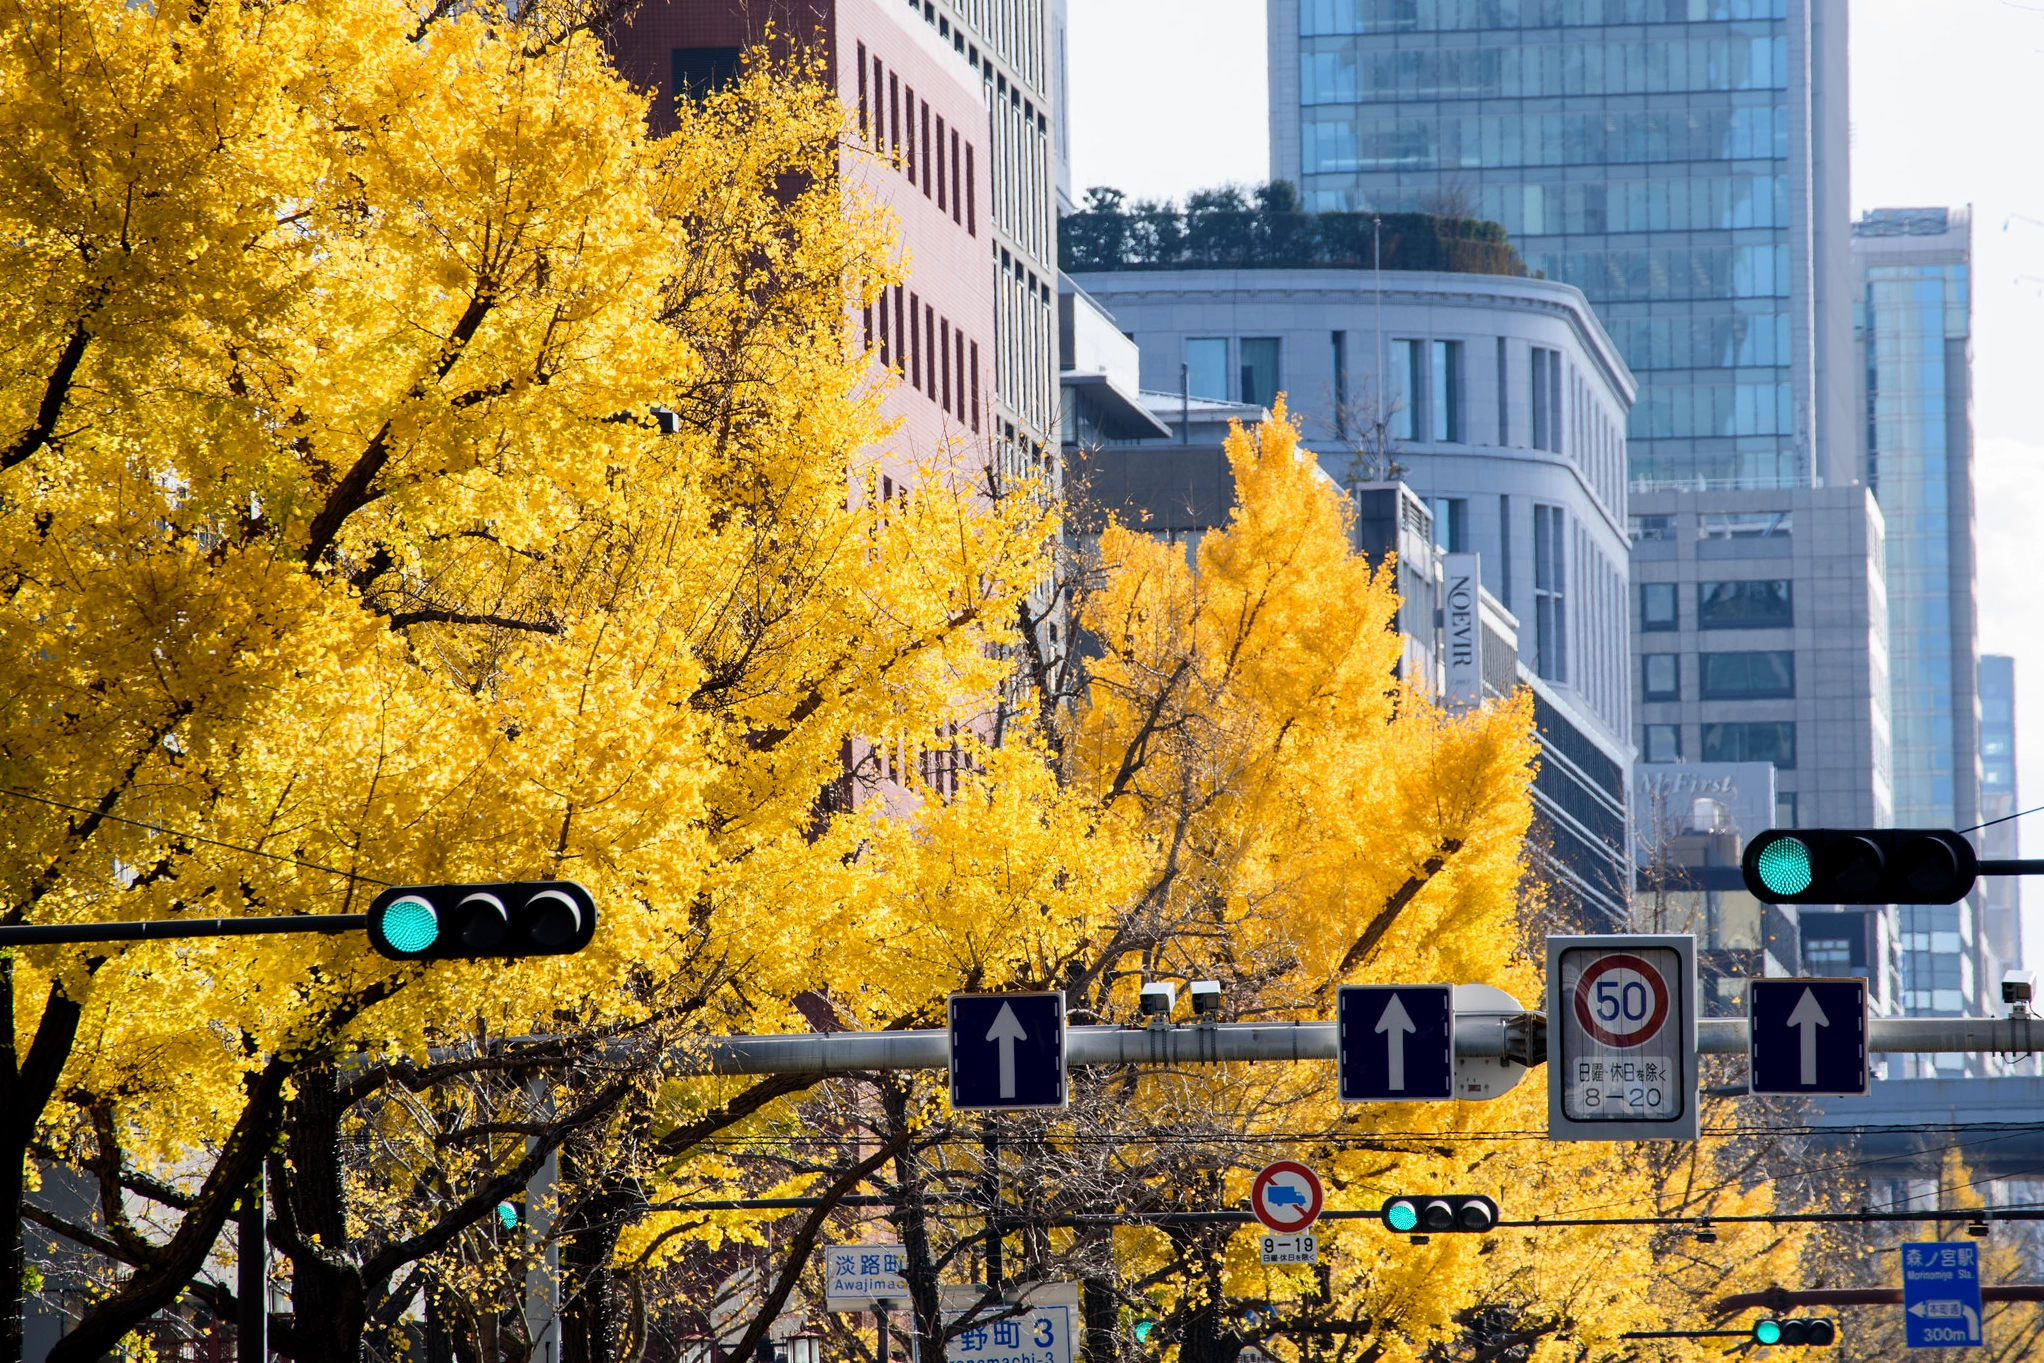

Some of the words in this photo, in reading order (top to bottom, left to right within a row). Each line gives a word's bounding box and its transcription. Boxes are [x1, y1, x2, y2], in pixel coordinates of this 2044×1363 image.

[1448, 576, 1472, 668] NOEVIR
[1596, 981, 1647, 1021] 50
[1906, 1248, 1975, 1267] 森ノ宮駅
[1034, 1318, 1055, 1348] 3
[1923, 1327, 1966, 1342] 300m
